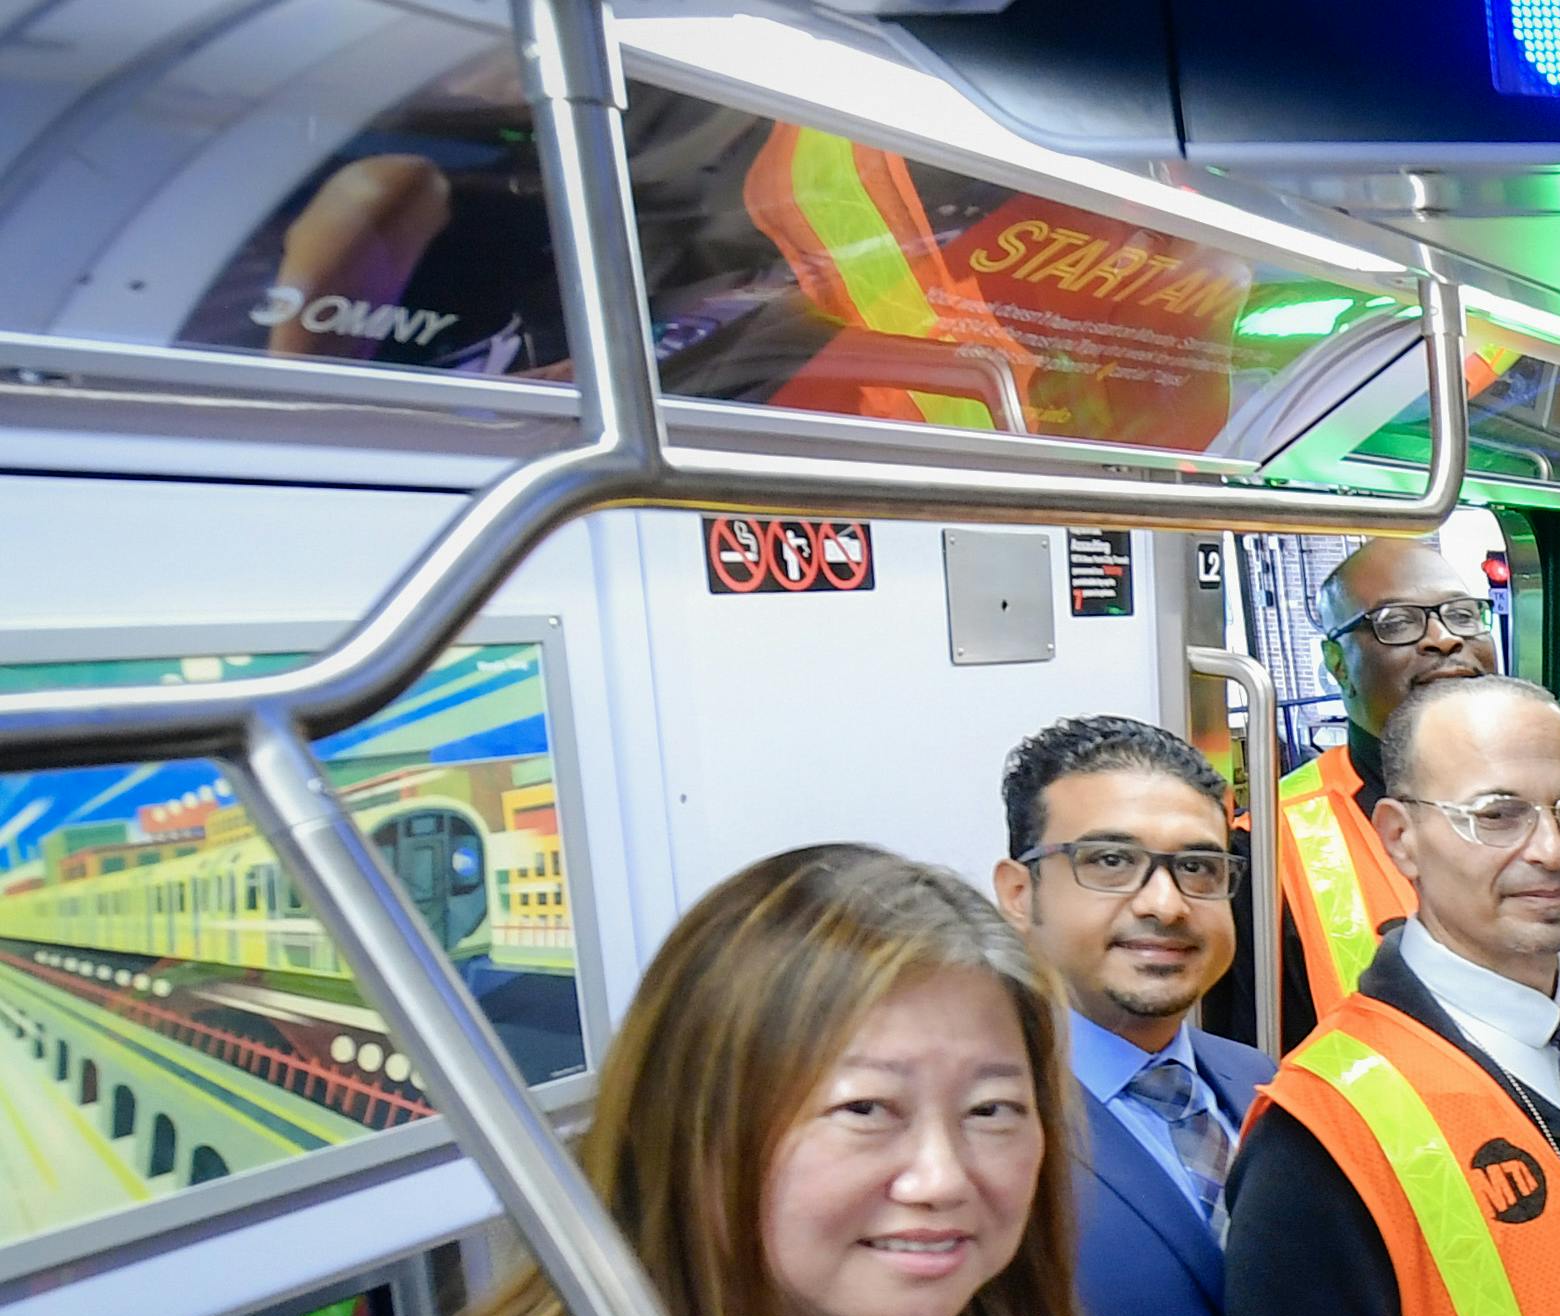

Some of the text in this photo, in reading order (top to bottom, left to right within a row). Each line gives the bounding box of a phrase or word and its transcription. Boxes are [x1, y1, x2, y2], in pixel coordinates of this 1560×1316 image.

[969, 220, 1182, 302] START
[301, 295, 459, 346] OMNY
[1199, 552, 1221, 582] L2
[1473, 1152, 1542, 1217] MTA
